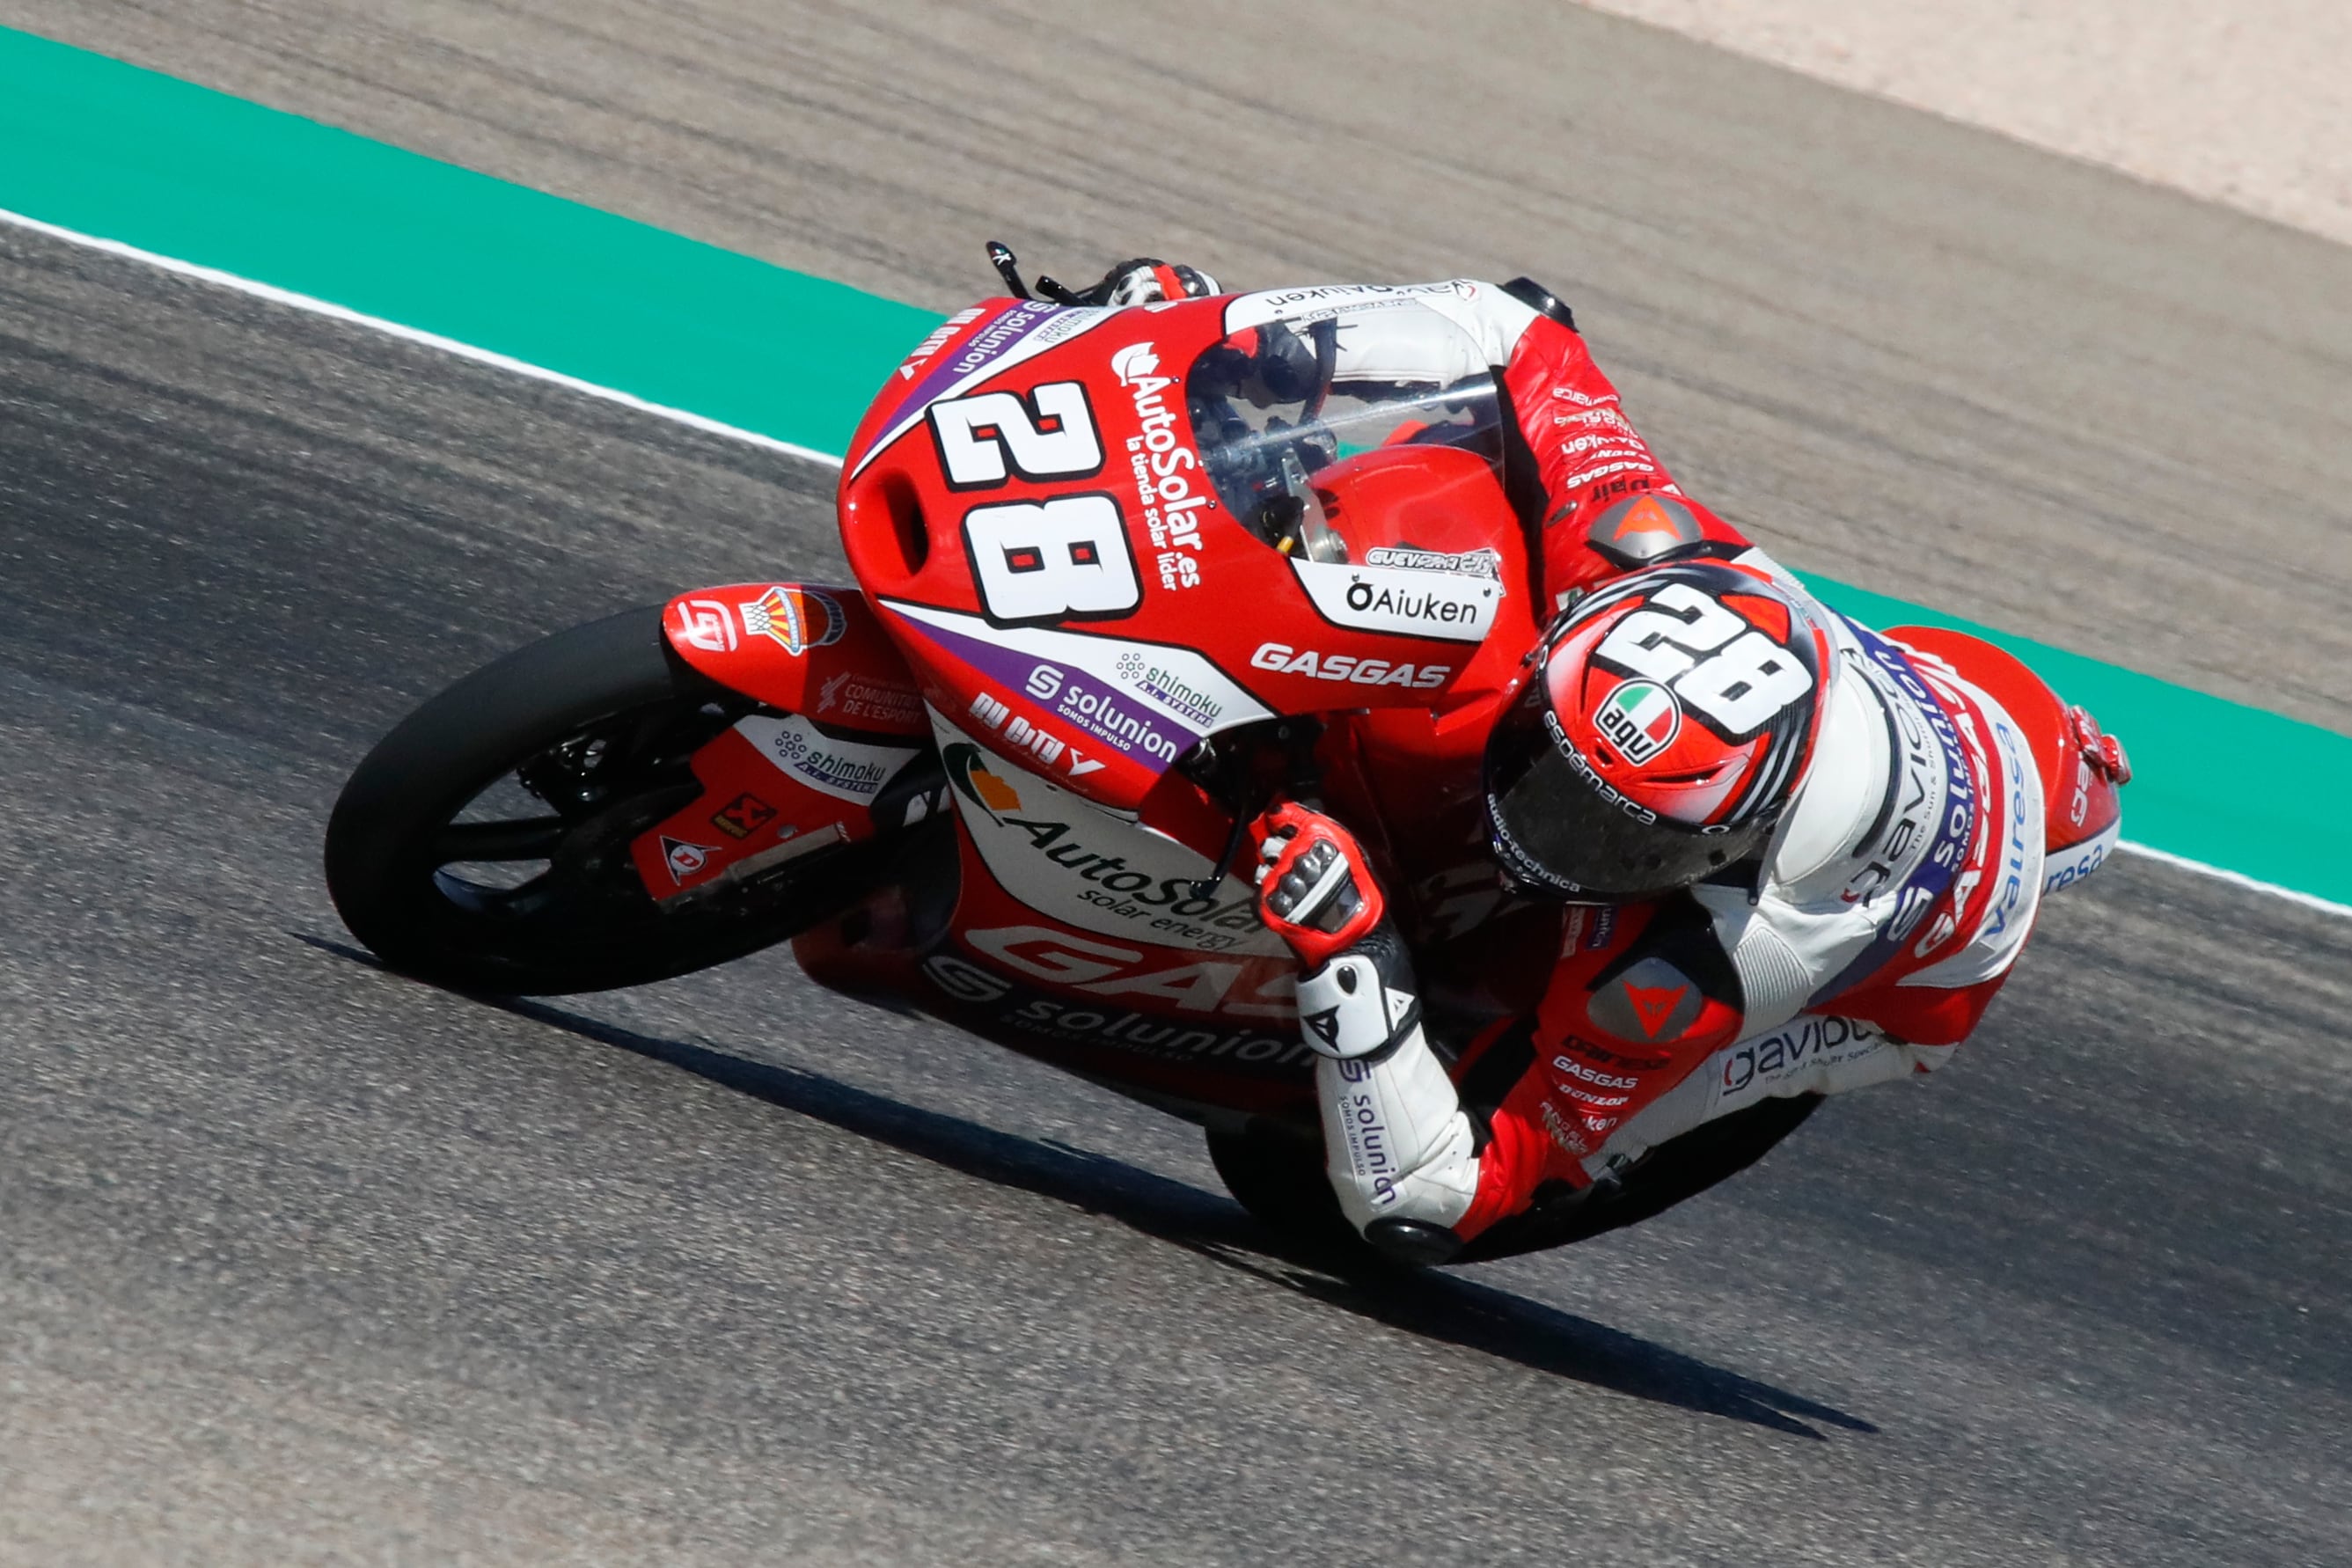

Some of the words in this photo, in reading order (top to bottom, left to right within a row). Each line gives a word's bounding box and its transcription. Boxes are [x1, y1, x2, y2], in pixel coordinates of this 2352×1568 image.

[1126, 437, 1141, 451] la
[1129, 454, 1154, 509] tienda
[1131, 377, 1207, 589] AutoSolar.es
[1565, 461, 1655, 489] GASGAS
[928, 379, 1141, 621] 28
[1143, 509, 1169, 558] solar
[1156, 553, 1177, 591] líder
[1373, 587, 1477, 624] Aiuken
[1250, 642, 1451, 688] GASGAS
[1596, 583, 1813, 736] 28
[1146, 666, 1223, 719] shimoku
[1162, 693, 1214, 729] SYSTEMS
[1056, 704, 1088, 729] SOMOS
[1088, 718, 1132, 752] IMPULSO
[1063, 685, 1178, 764] solunion
[1601, 708, 1654, 762] agv
[807, 751, 885, 783] shimoku
[1923, 799, 1936, 821] Sun
[1985, 722, 2025, 937] valresa
[1487, 793, 1581, 893] audio-technica
[1076, 889, 1151, 922] solar
[1149, 916, 1247, 952] energy
[1552, 1056, 1639, 1089] GASGAS
[1558, 1084, 1630, 1106] DUNLOP
[1339, 1095, 1355, 1132] SOMOS
[1348, 1134, 1366, 1176] IMPULSO
